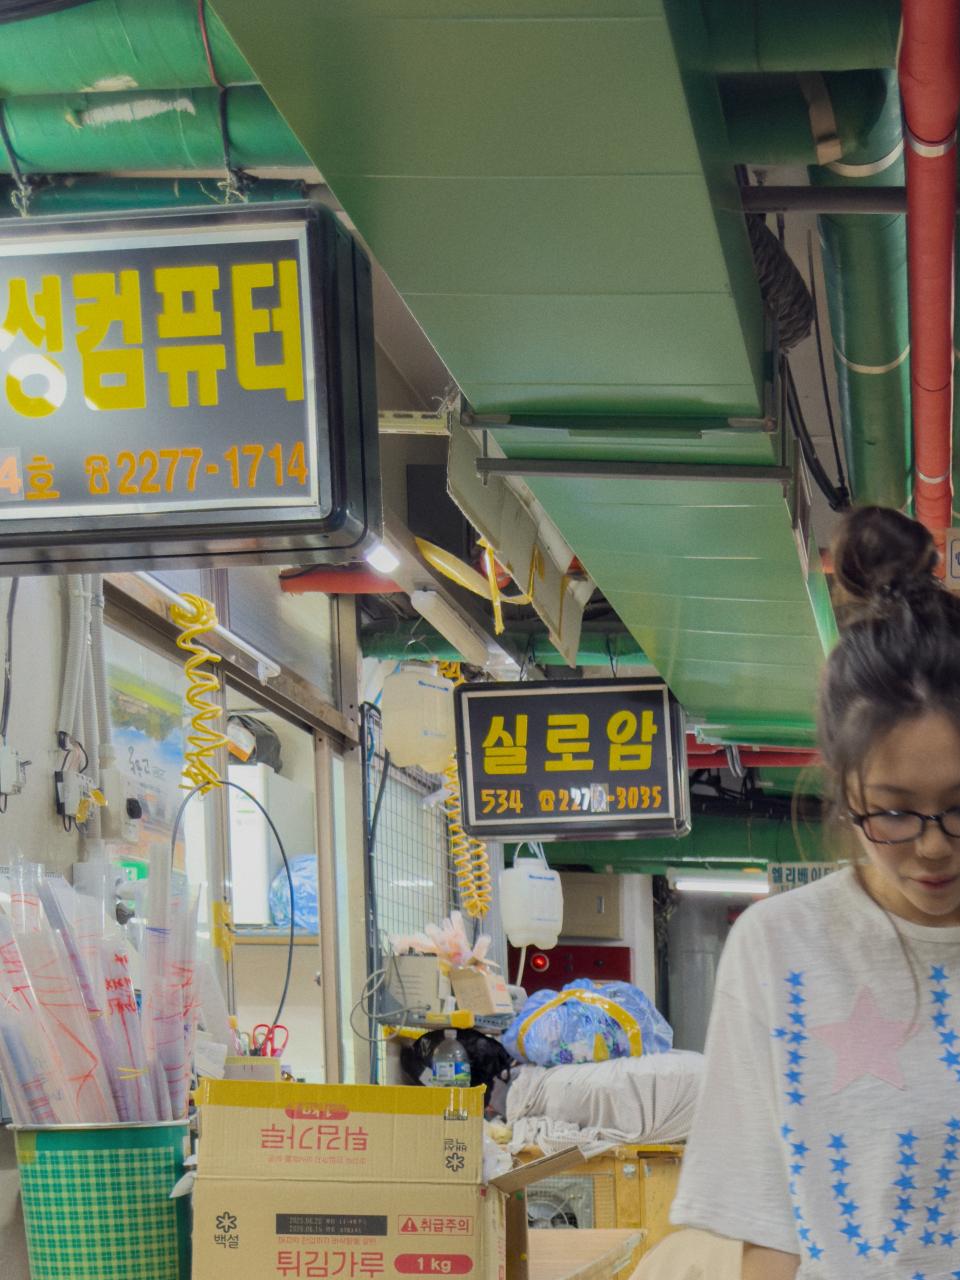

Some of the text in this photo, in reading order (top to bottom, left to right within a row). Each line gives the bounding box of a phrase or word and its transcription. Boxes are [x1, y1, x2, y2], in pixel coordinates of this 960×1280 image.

[0, 259, 305, 418] 성컴퓨터
[117, 441, 309, 496] 2277-1714
[482, 710, 658, 775] 실로암
[481, 788, 524, 814] 534
[261, 1124, 369, 1152] 튀김가루
[420, 1218, 469, 1233] 취급주의
[214, 1234, 240, 1249] 백설
[276, 1250, 384, 1278] 튀김가루
[417, 1257, 451, 1273] 1 kg
